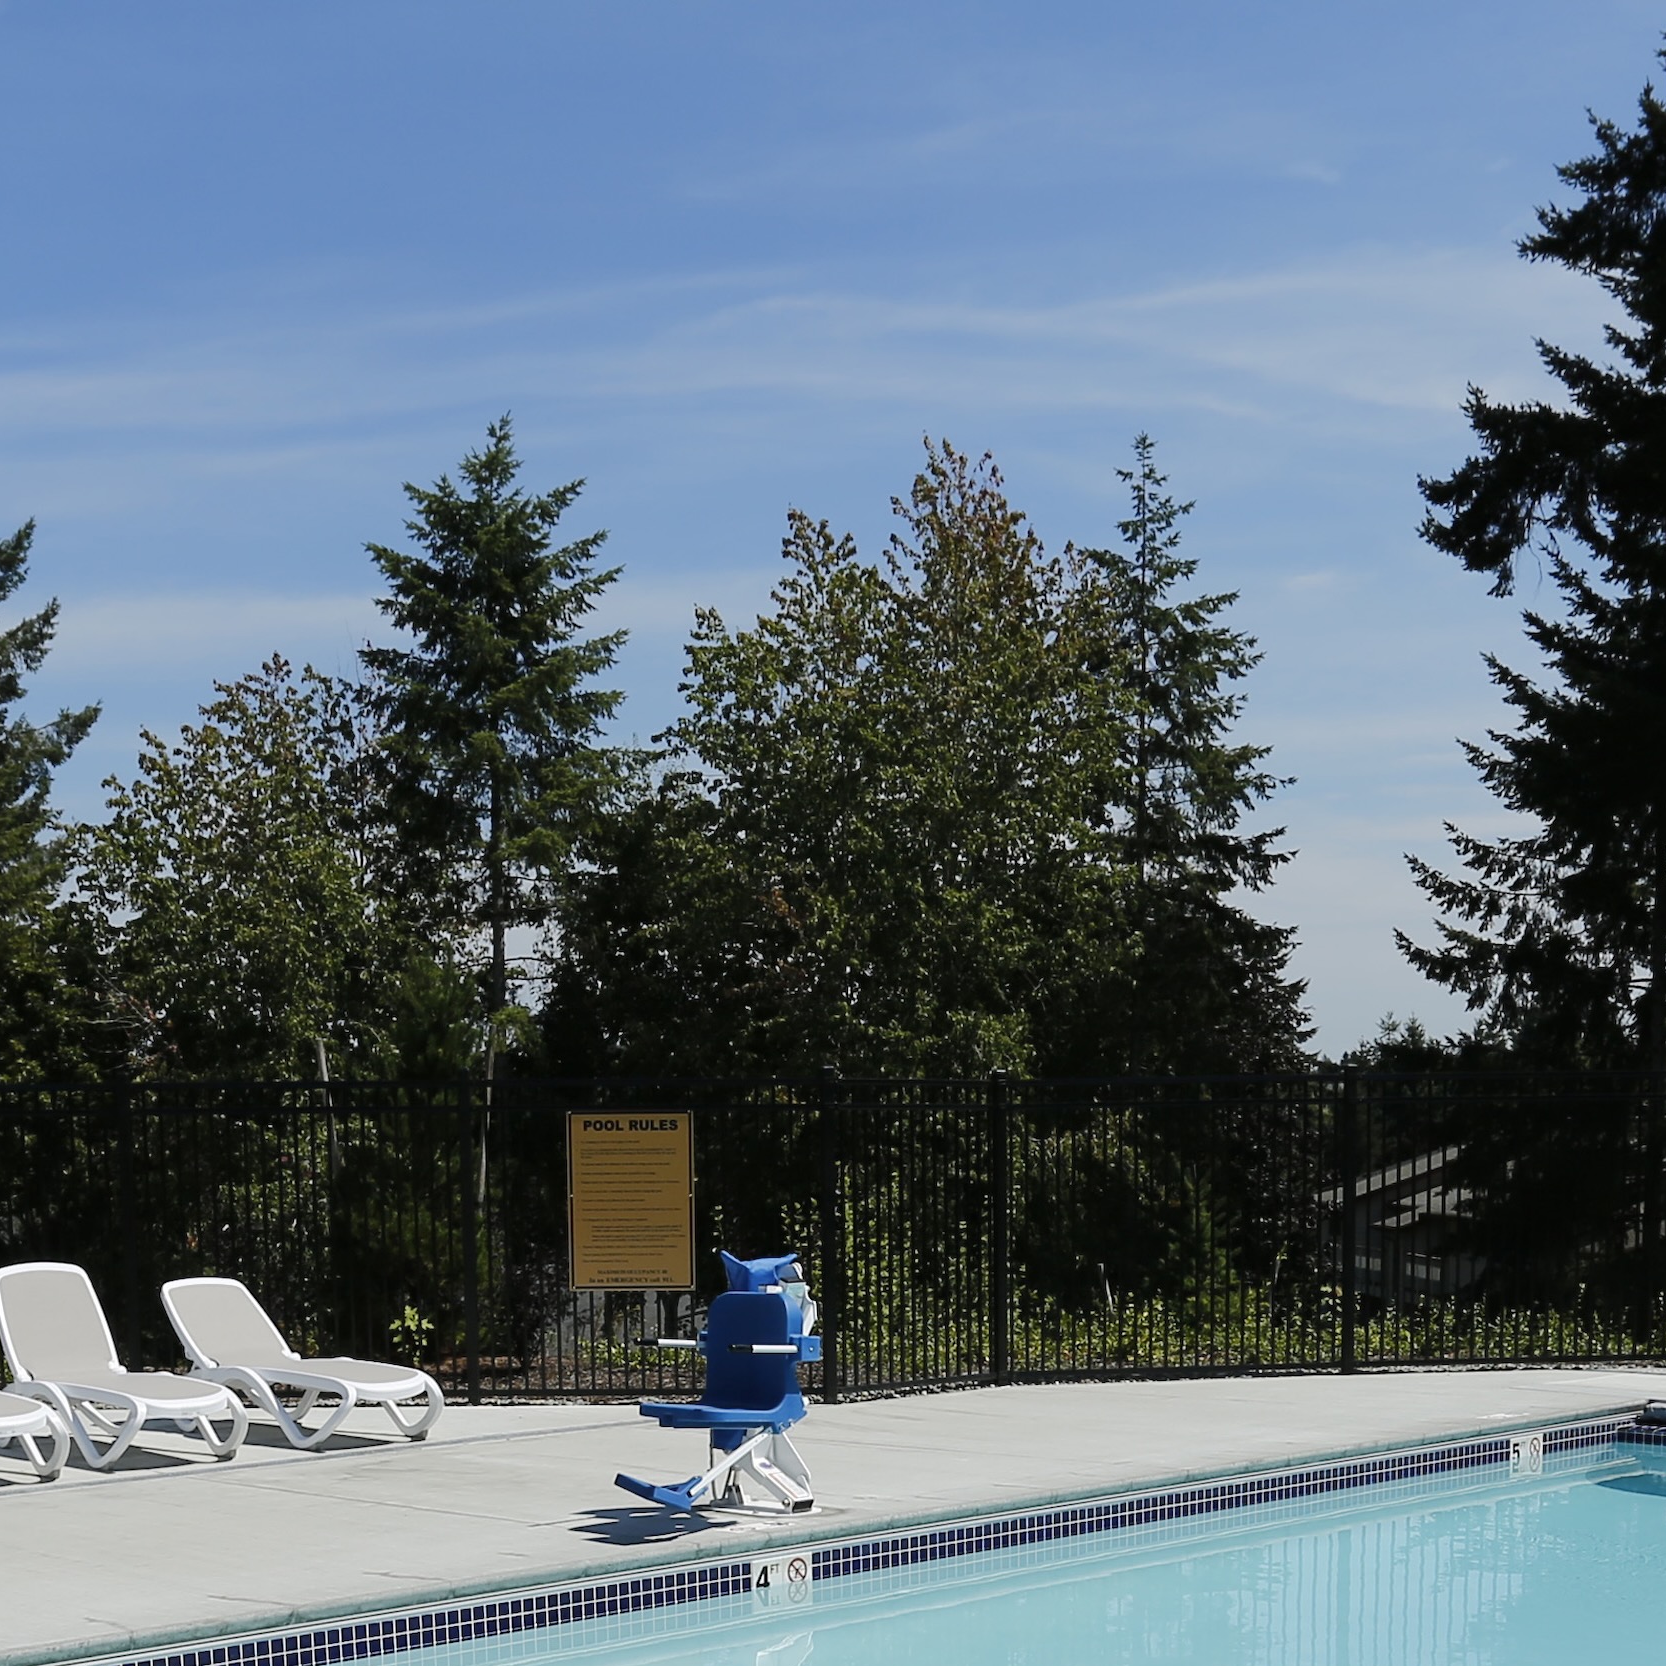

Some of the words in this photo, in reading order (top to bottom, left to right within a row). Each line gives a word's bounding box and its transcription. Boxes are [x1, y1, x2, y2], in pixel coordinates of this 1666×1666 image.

[583, 1120, 624, 1131] POOL
[628, 1119, 678, 1131] RULES
[756, 1565, 770, 1588] 4
[770, 1563, 780, 1575] FT
